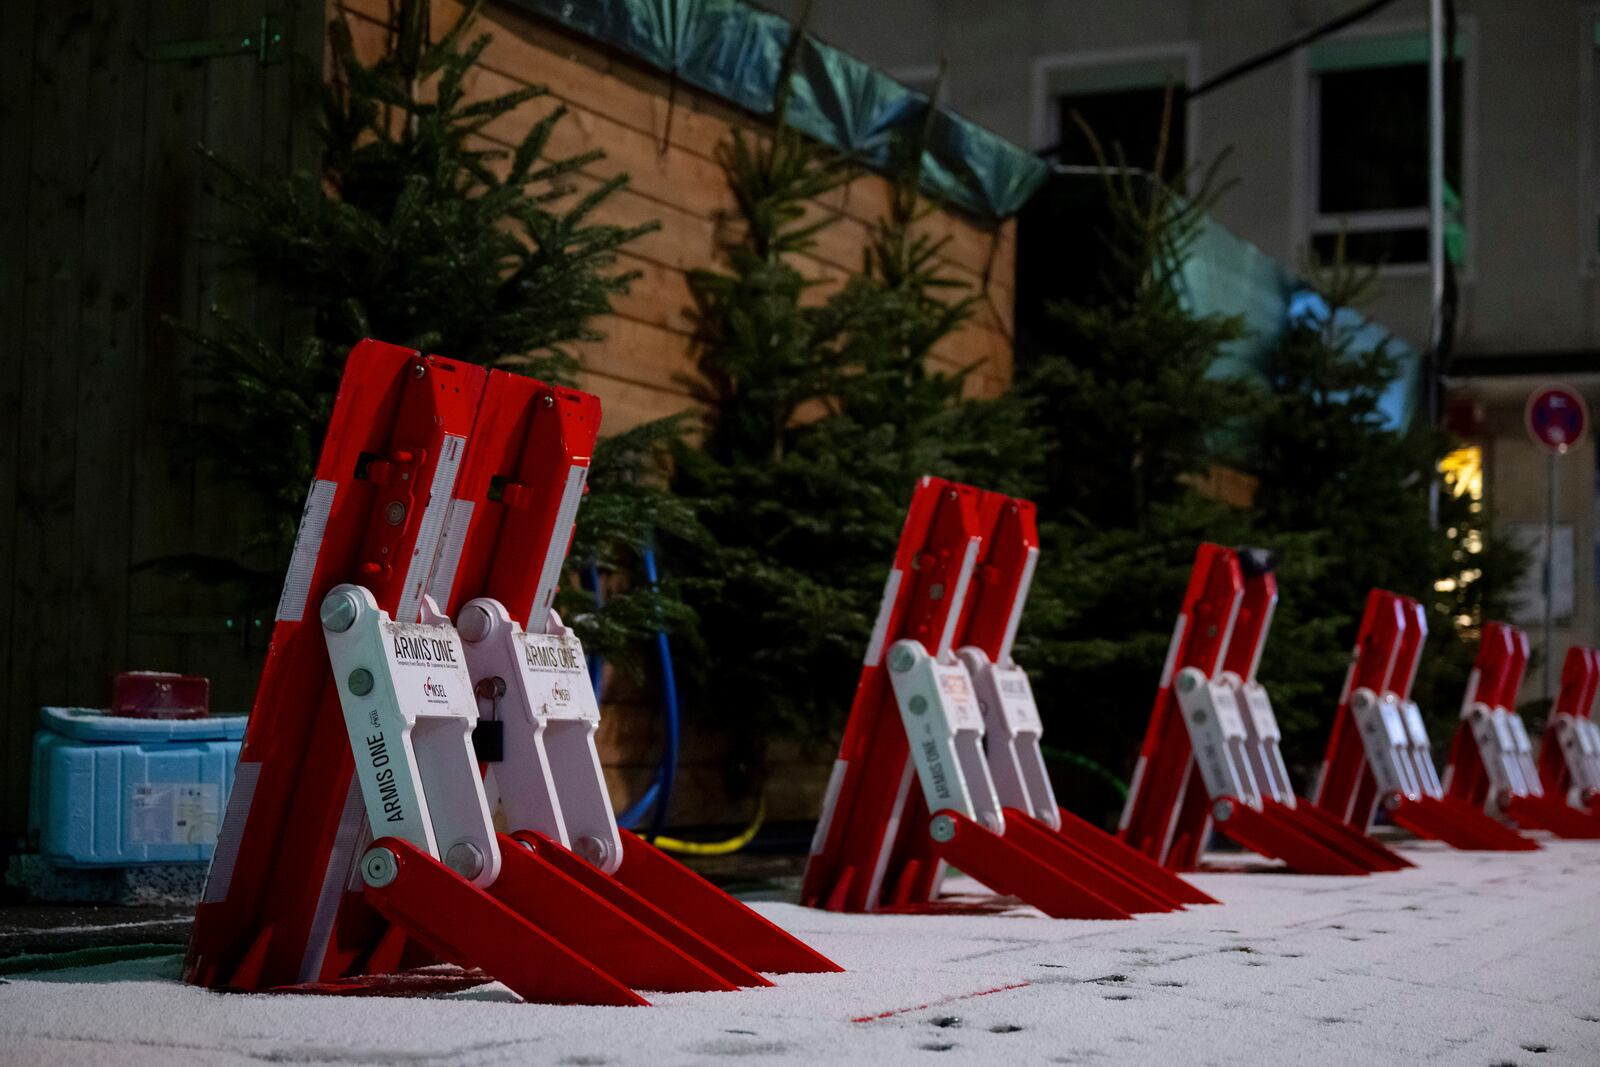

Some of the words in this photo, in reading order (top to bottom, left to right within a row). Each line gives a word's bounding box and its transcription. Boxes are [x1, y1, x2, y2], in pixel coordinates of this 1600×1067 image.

[394, 636, 432, 661] ARMIS
[431, 639, 457, 663] ONE
[525, 645, 558, 668] ARMIS
[557, 648, 580, 669] ONE
[366, 731, 390, 768] ONE
[375, 768, 404, 823] ARMIS
